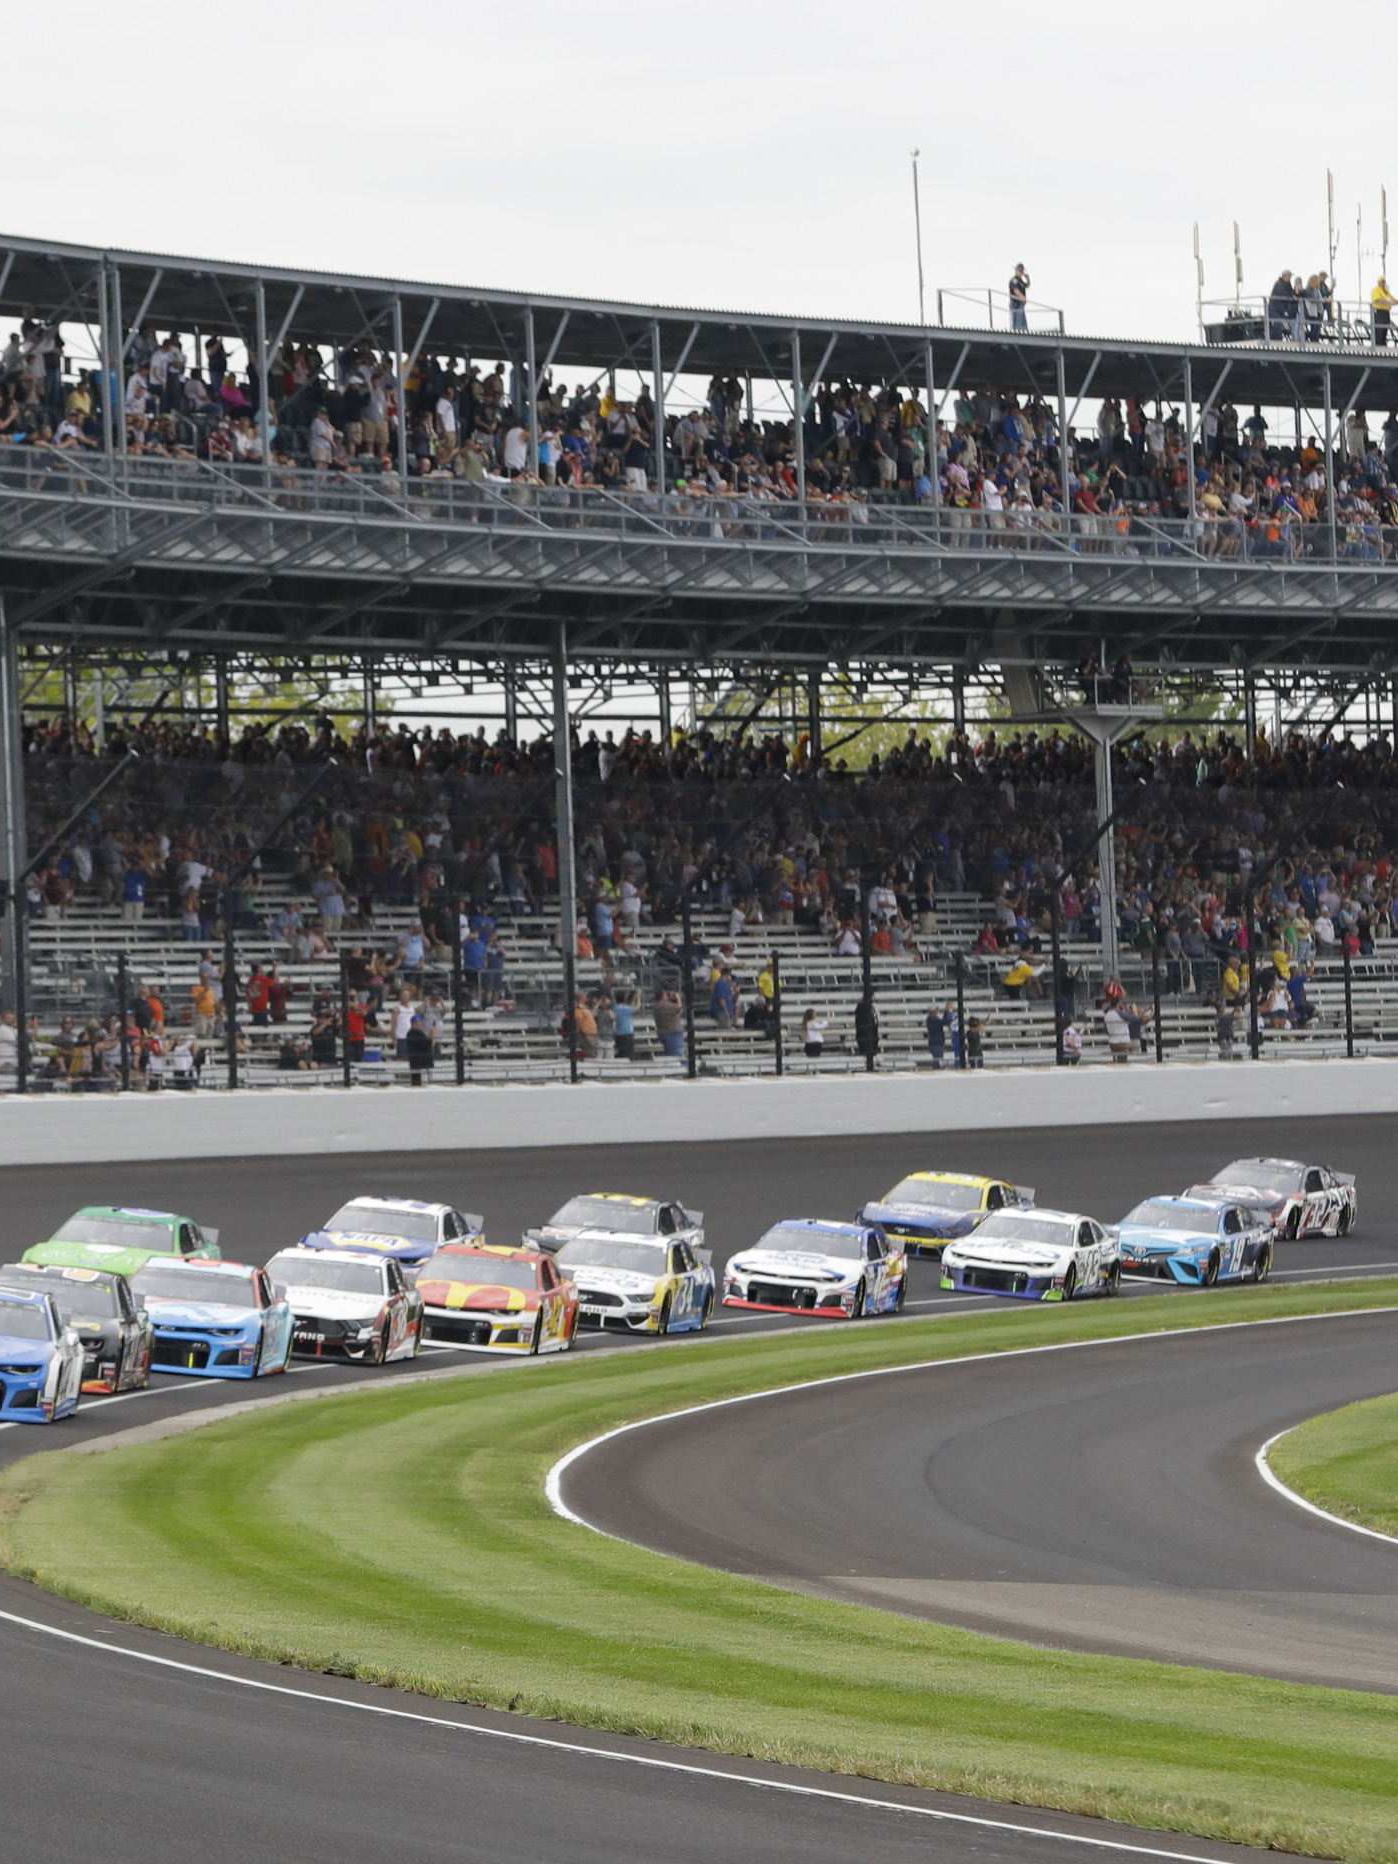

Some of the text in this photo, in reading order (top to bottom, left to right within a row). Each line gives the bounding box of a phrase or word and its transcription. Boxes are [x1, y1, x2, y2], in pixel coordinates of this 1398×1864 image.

[1307, 1198, 1326, 1229] 32
[341, 1232, 401, 1246] NAPA
[1229, 1239, 1246, 1273] 19
[1083, 1251, 1101, 1287] 13
[678, 1277, 695, 1314] 34
